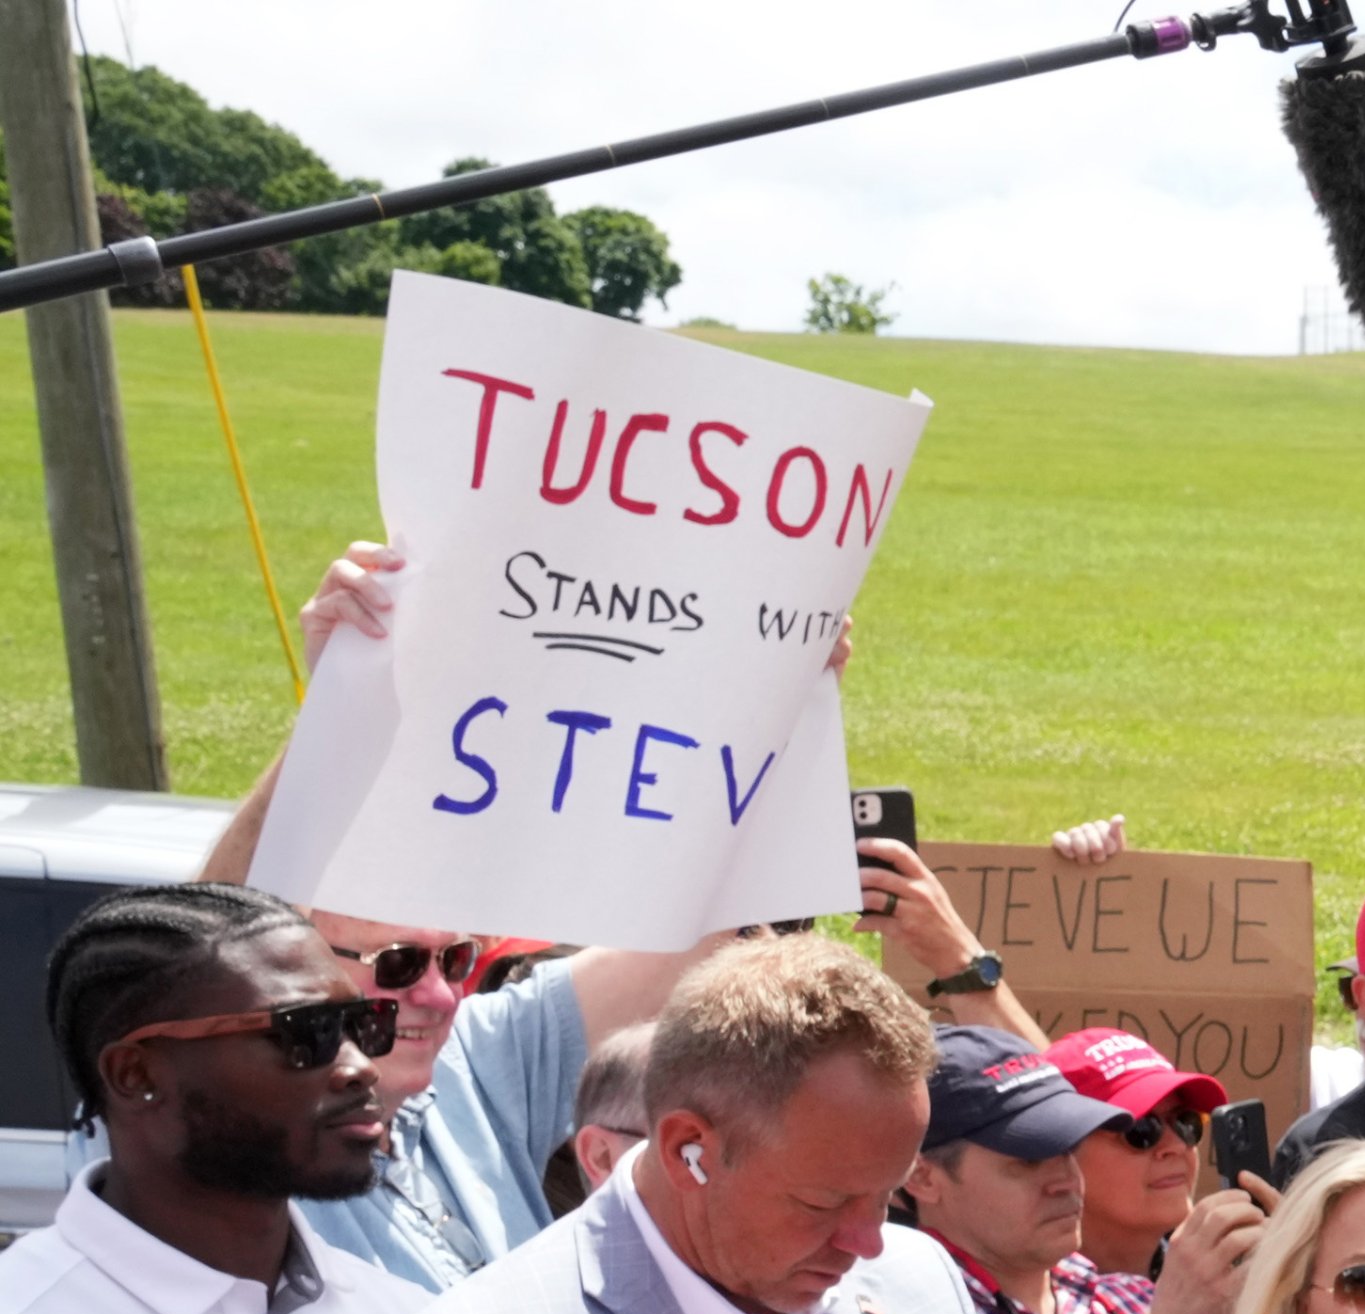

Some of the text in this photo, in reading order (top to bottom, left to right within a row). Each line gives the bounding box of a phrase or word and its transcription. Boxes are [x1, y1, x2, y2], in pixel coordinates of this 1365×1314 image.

[441, 367, 893, 549] TUCSON
[499, 550, 847, 646] STANDS WITH
[1158, 877, 1279, 964] WE
[1159, 1010, 1284, 1080] YOU
